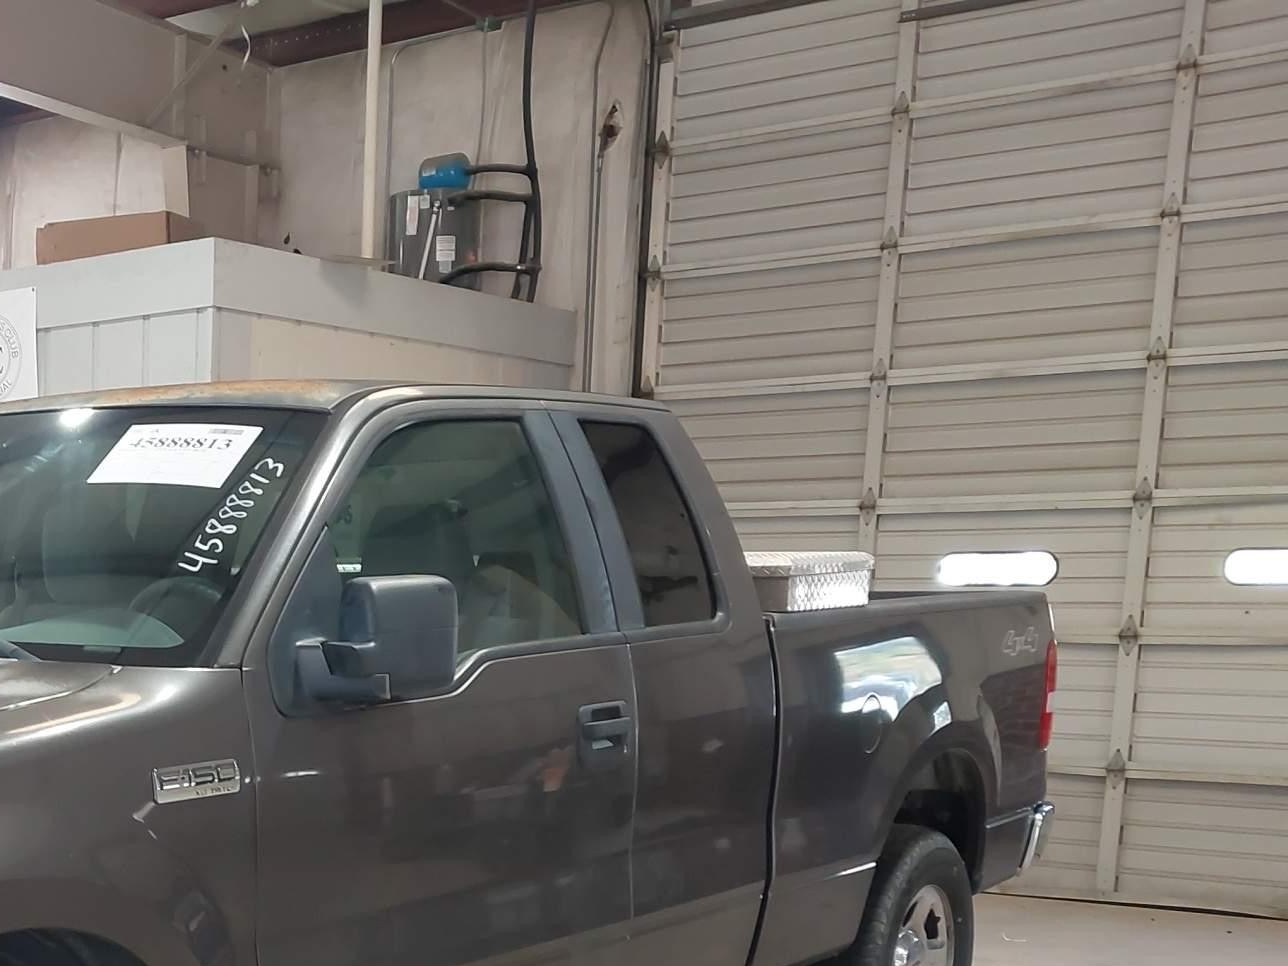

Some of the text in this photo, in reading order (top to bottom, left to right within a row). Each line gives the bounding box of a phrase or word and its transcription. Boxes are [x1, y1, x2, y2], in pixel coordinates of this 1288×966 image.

[3, 327, 20, 359] CLUB
[128, 437, 232, 450] 45888813
[177, 456, 286, 573] 45888813
